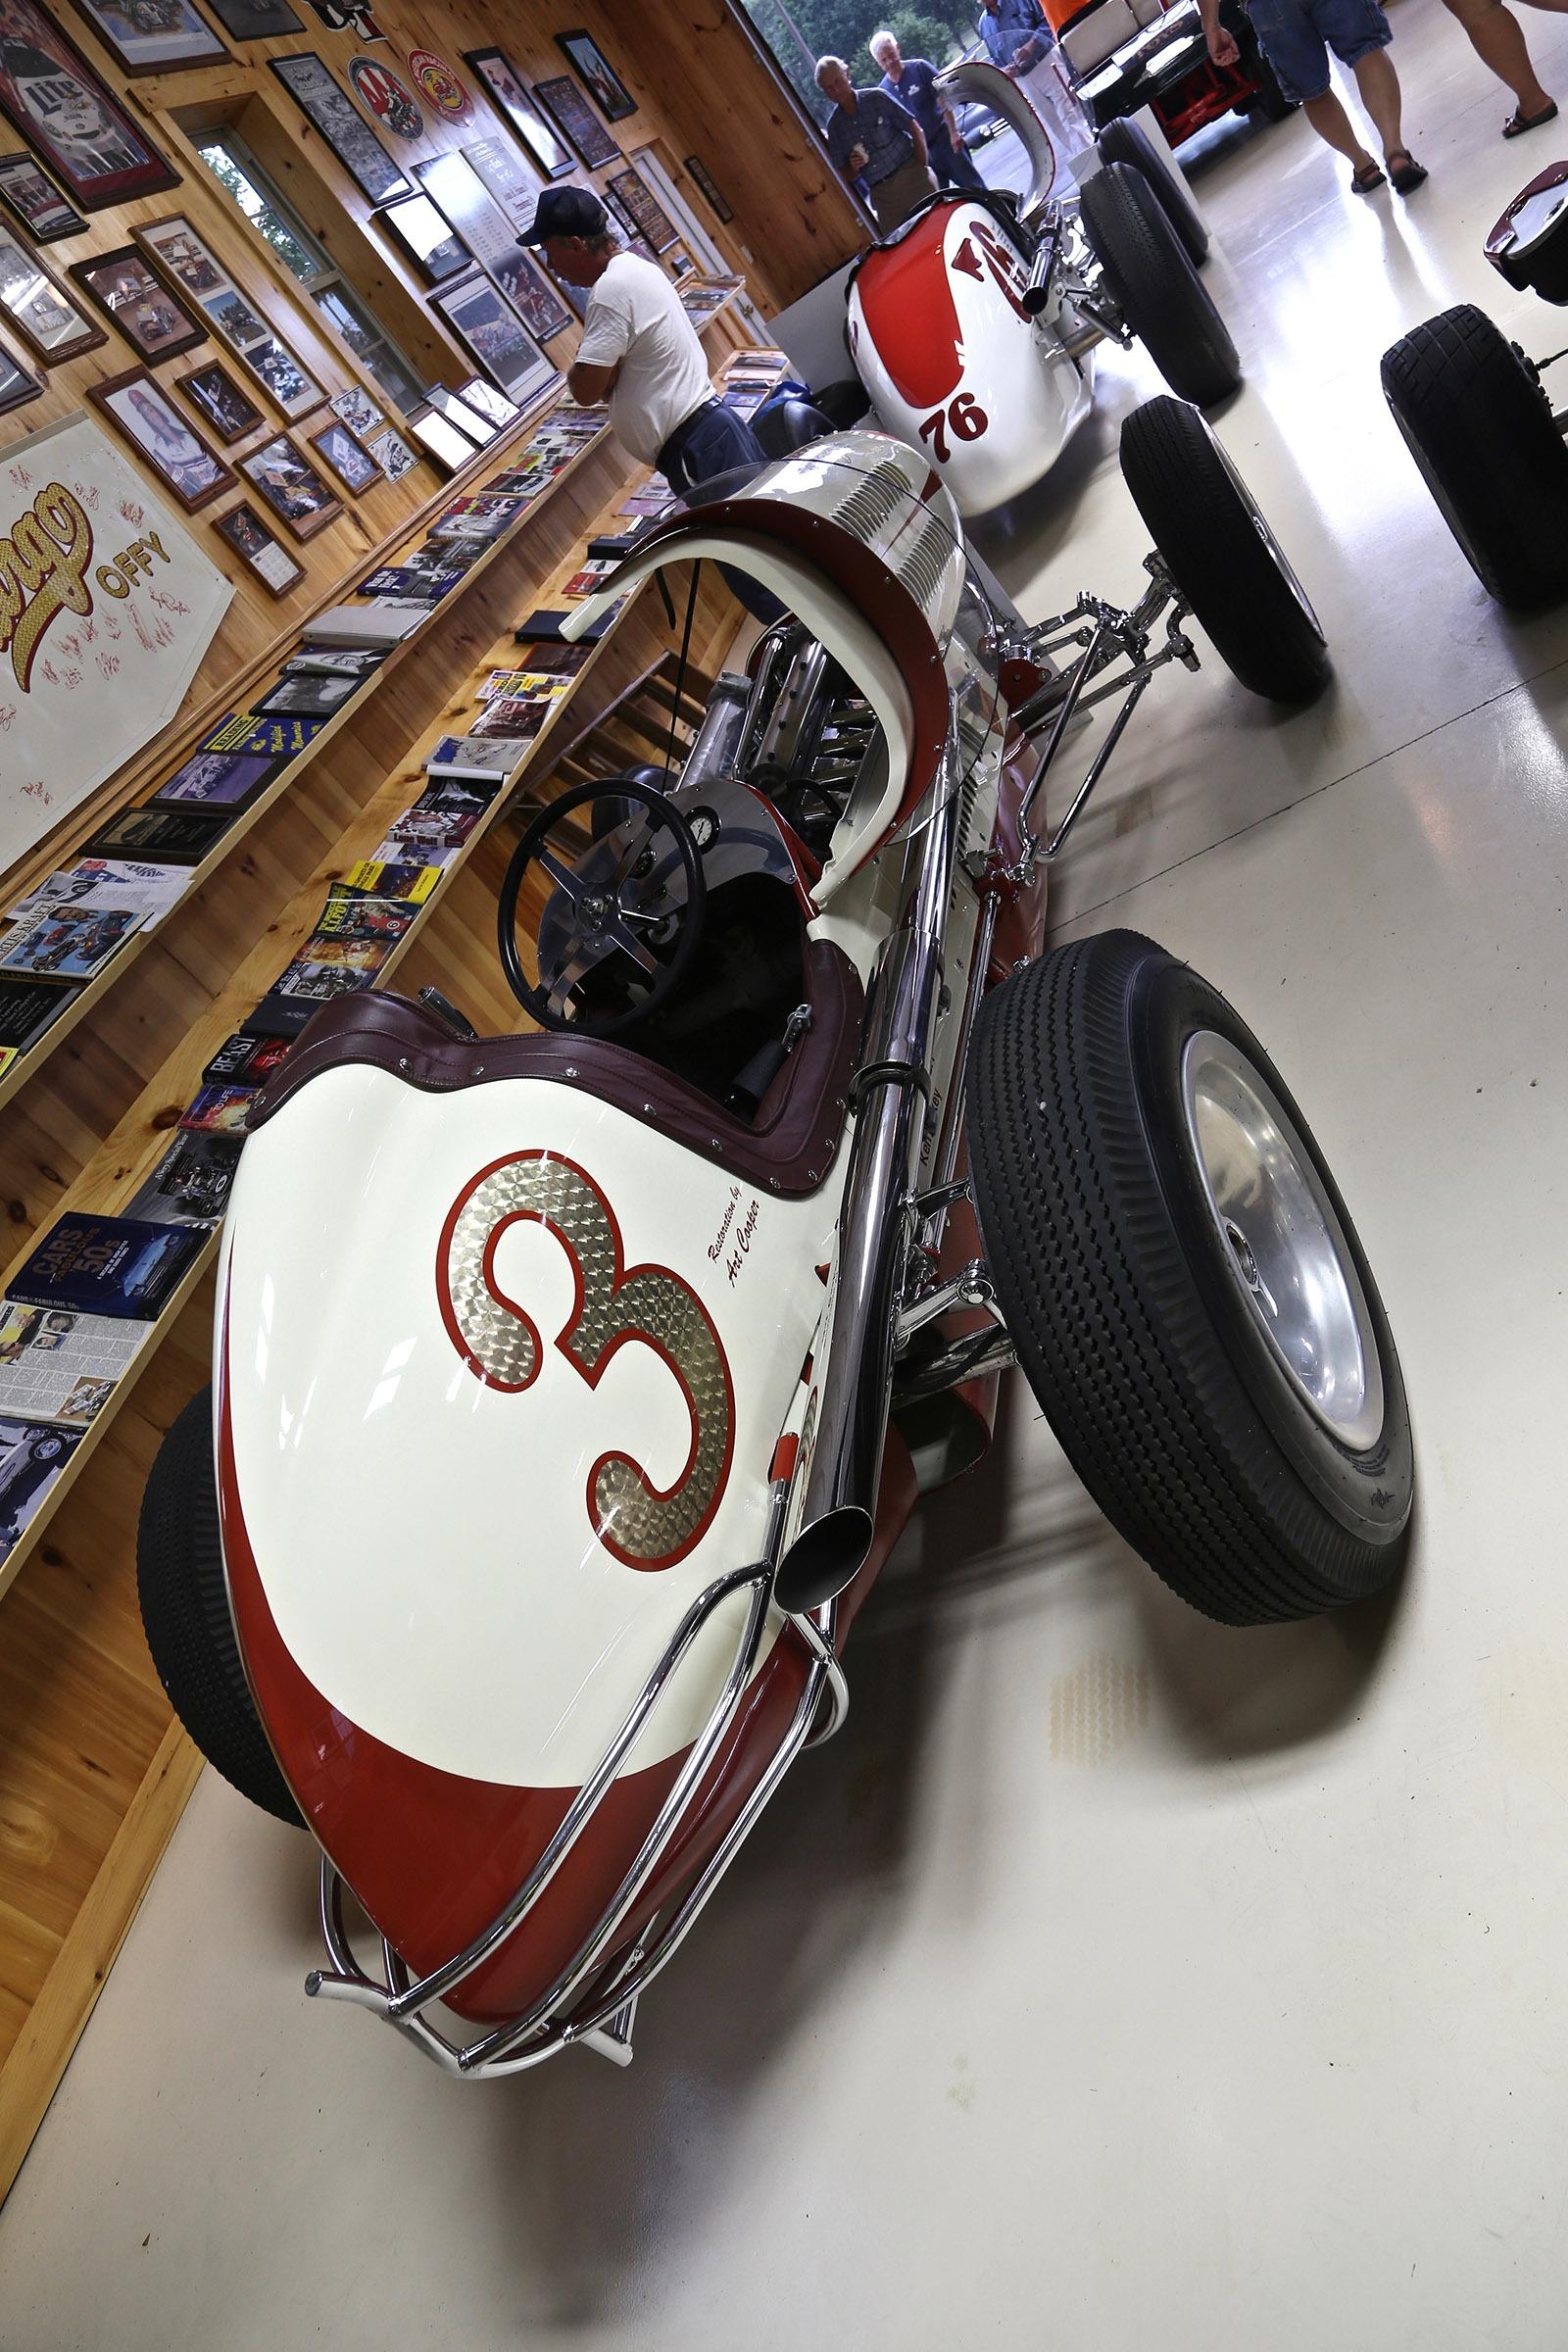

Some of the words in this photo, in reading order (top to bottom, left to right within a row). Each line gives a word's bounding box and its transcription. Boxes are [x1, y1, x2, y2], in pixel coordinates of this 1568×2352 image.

[24, 80, 83, 118] Lite
[918, 392, 989, 464] 76
[96, 531, 171, 599] OFFY
[394, 833, 416, 843] Lone
[417, 835, 438, 846] Wolf
[210, 1035, 256, 1073] BEAST
[210, 1102, 224, 1112] TO
[221, 1089, 233, 1102] LIFE
[32, 1229, 84, 1274] CARS
[708, 1200, 736, 1264] Restoration
[729, 1186, 742, 1200] by
[726, 1249, 743, 1289] Art
[736, 1200, 760, 1253] Cooper
[435, 1149, 737, 1572] 3
